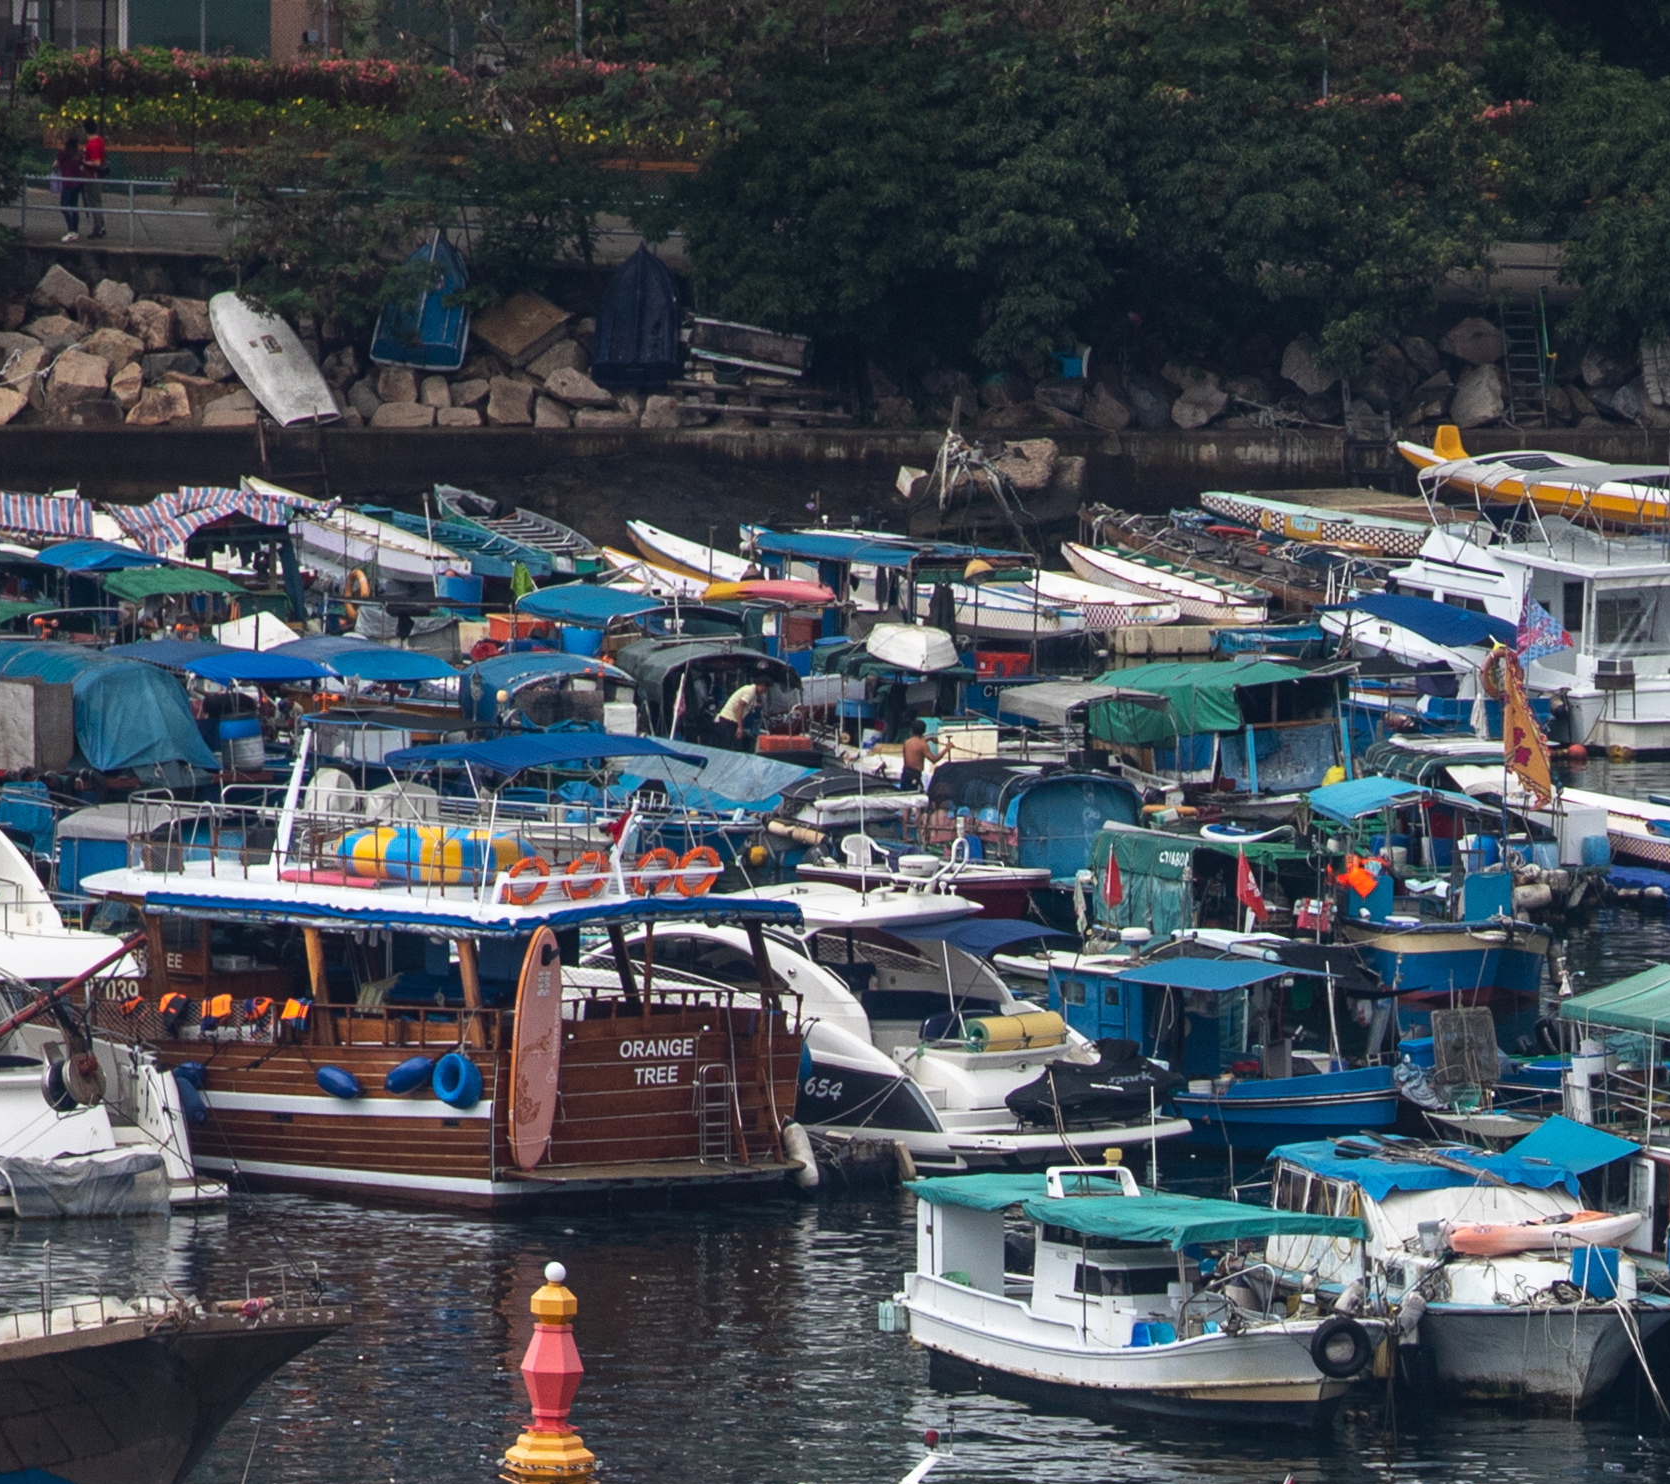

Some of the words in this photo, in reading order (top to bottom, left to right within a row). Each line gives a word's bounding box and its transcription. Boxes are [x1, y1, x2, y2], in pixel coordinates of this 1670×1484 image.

[617, 1039, 694, 1058] ORANGE
[633, 1066, 678, 1085] TREE
[805, 1077, 843, 1101] 654
